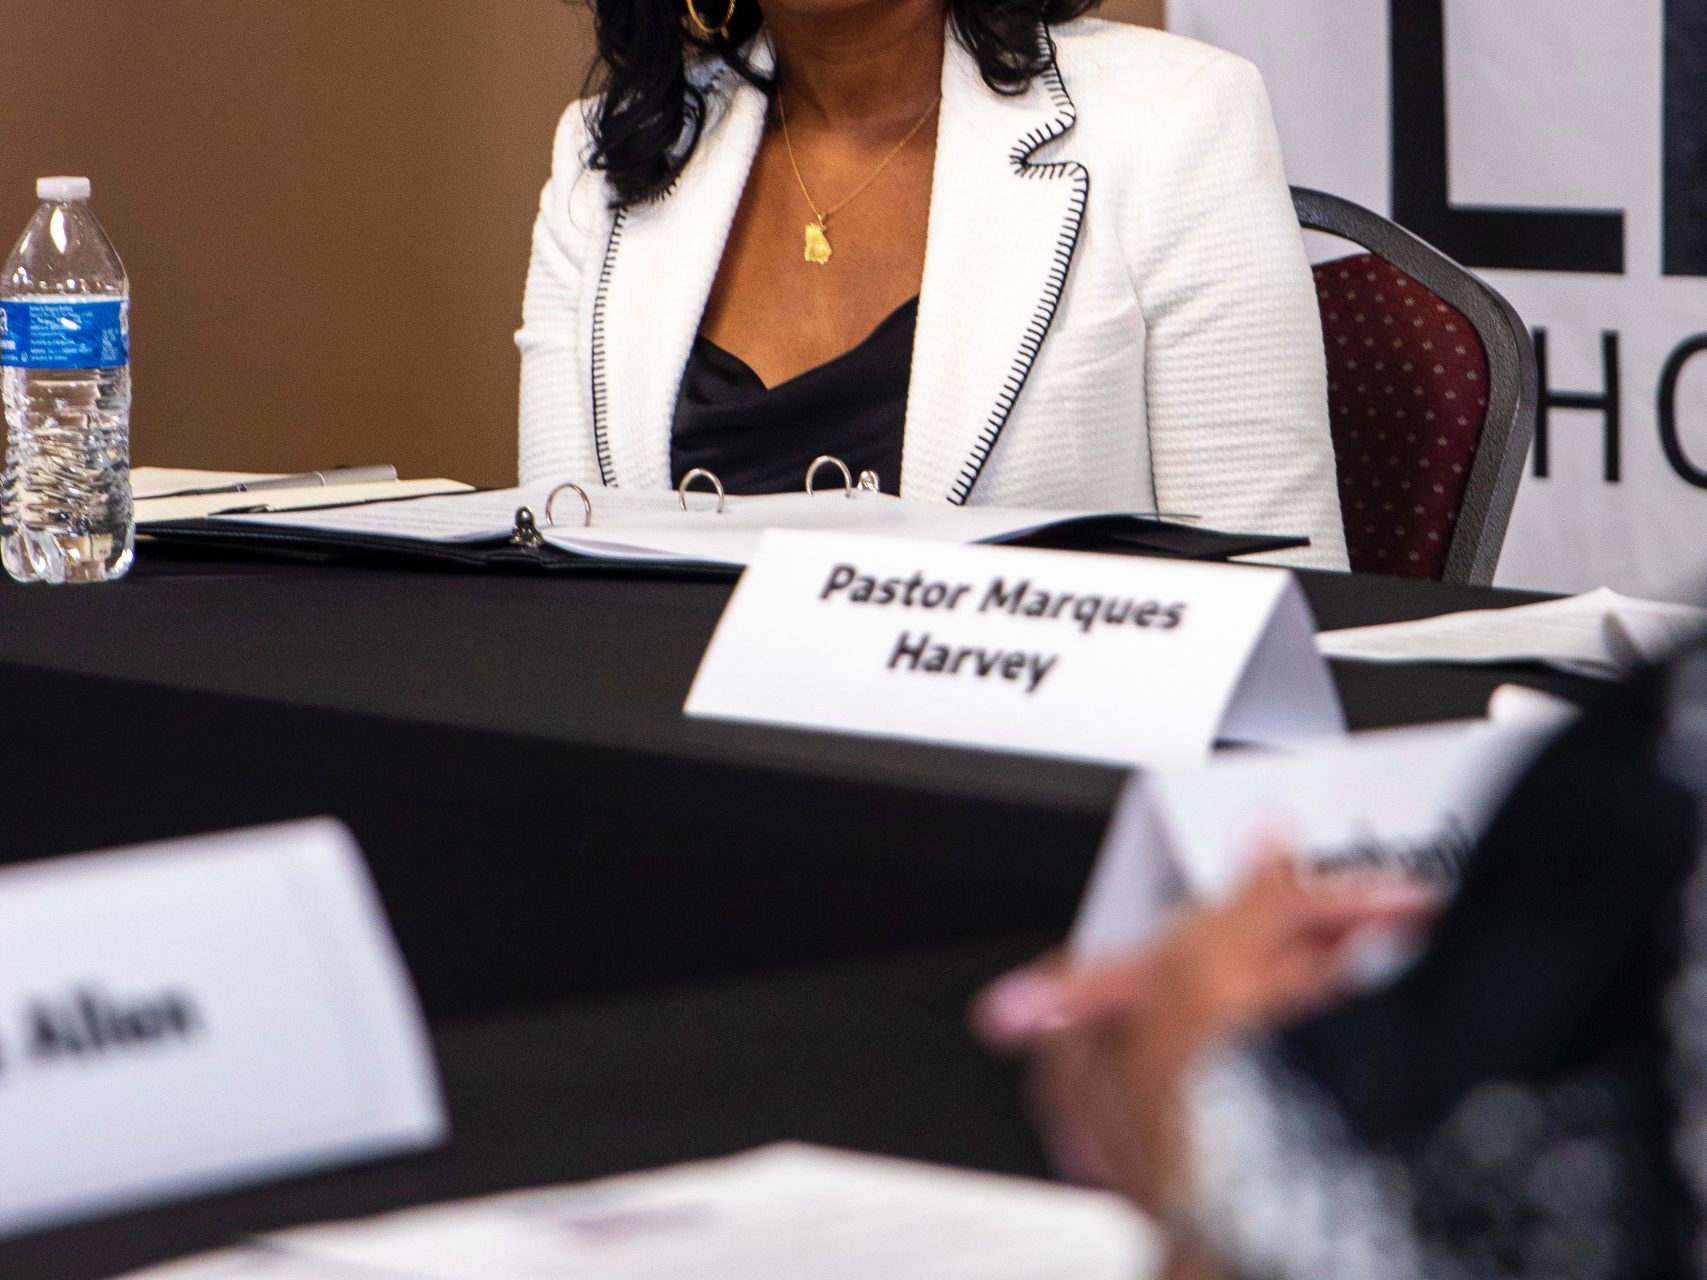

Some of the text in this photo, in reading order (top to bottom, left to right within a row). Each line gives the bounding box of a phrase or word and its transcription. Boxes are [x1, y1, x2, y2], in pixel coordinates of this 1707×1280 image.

[818, 563, 1188, 633] Pastor Marques
[886, 630, 1058, 694] Harvey
